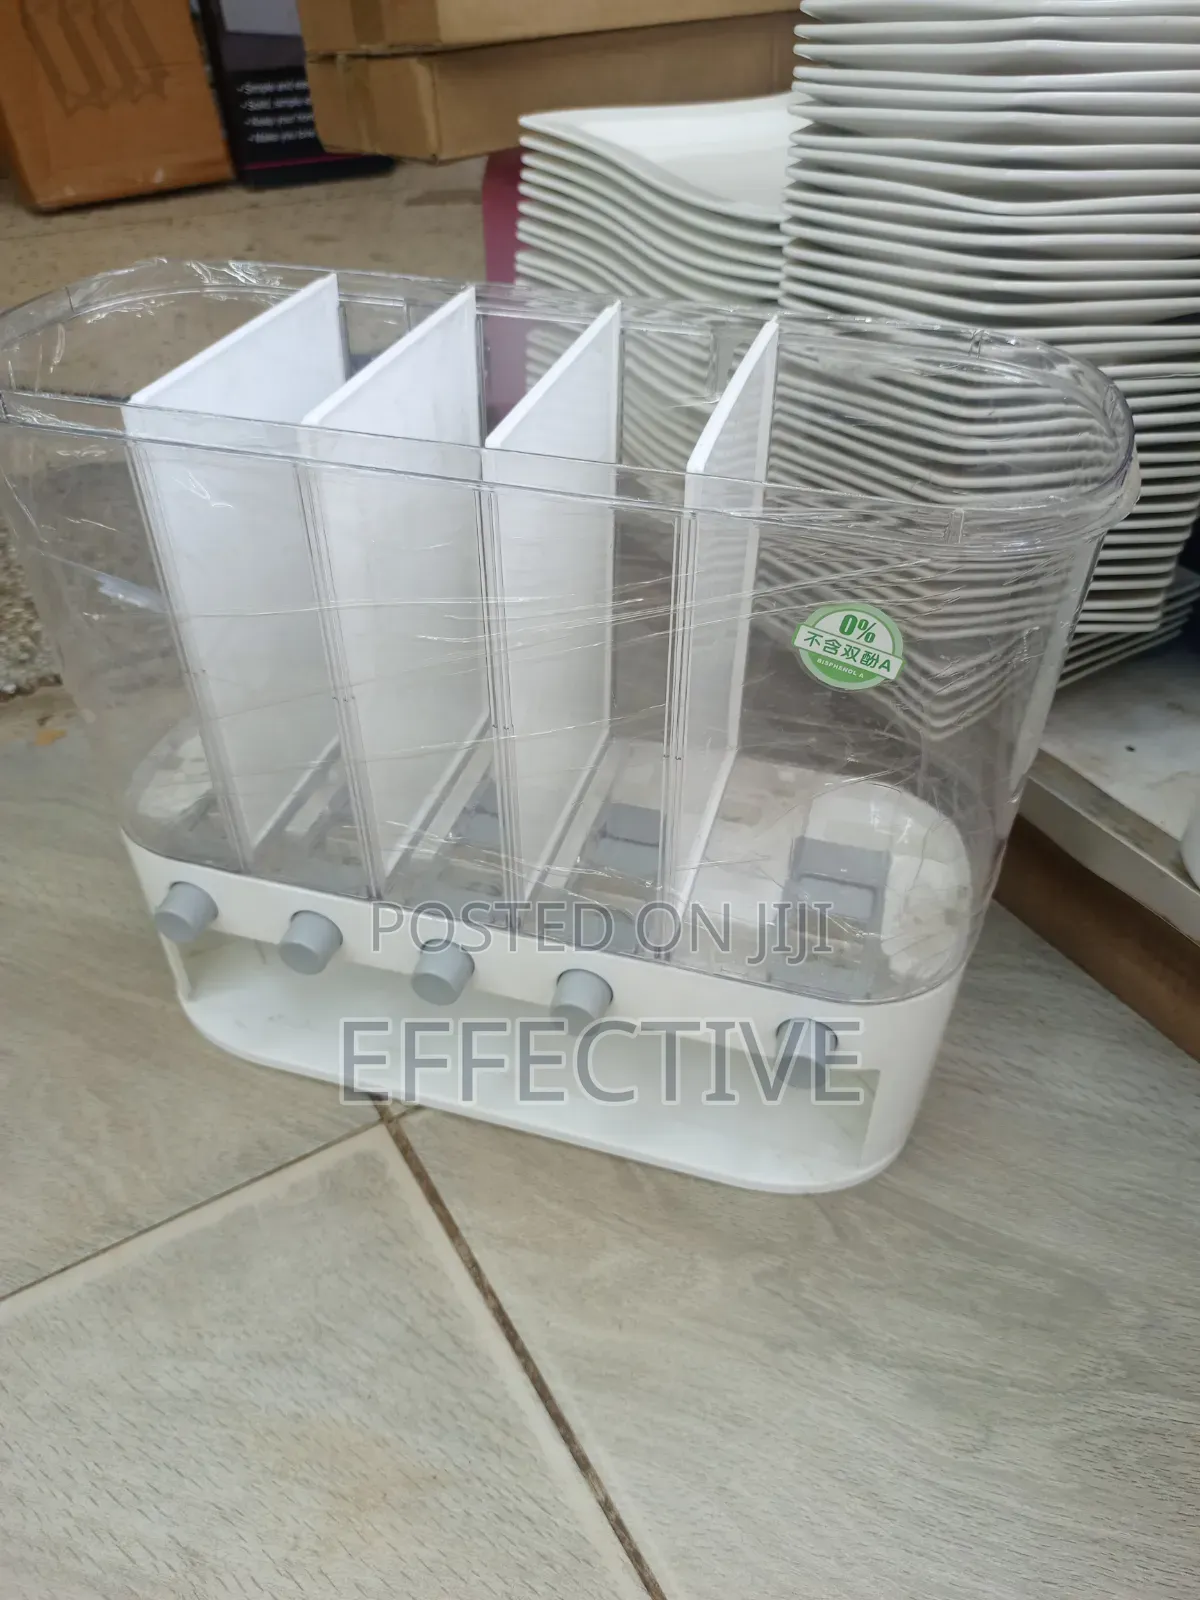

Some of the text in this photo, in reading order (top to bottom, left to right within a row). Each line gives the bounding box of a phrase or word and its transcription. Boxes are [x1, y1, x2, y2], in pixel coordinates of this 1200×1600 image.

[839, 614, 877, 643] 0%
[803, 630, 891, 673] 不含双酚A
[816, 658, 857, 676] BISPHENOL
